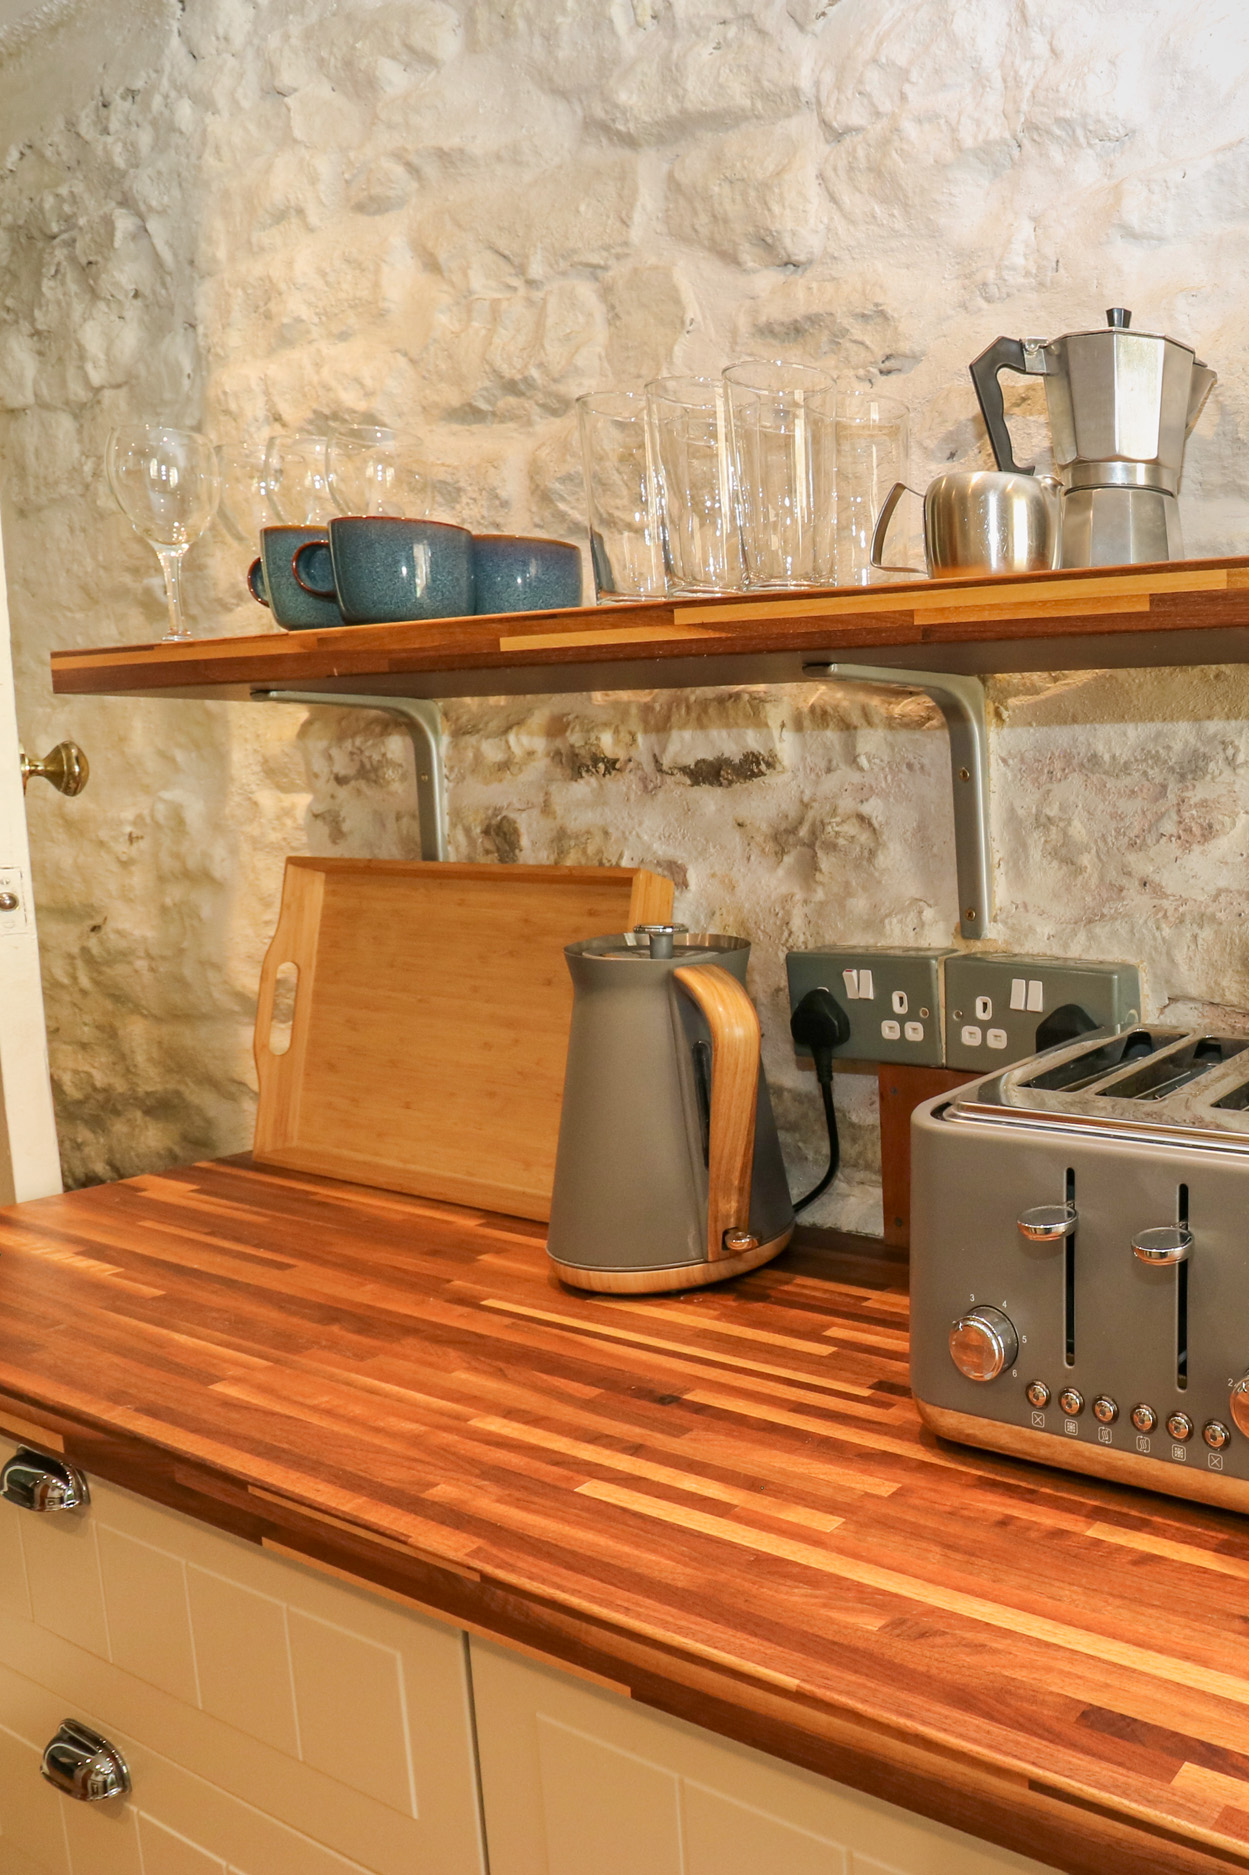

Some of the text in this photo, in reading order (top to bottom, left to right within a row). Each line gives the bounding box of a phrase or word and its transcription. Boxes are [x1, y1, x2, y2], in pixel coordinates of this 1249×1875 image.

[969, 1293, 975, 1302] 3
[1002, 1300, 1007, 1308] 4
[1022, 1335, 1027, 1344] 5
[1012, 1369, 1018, 1378] 6
[1227, 1378, 1233, 1387] 2
